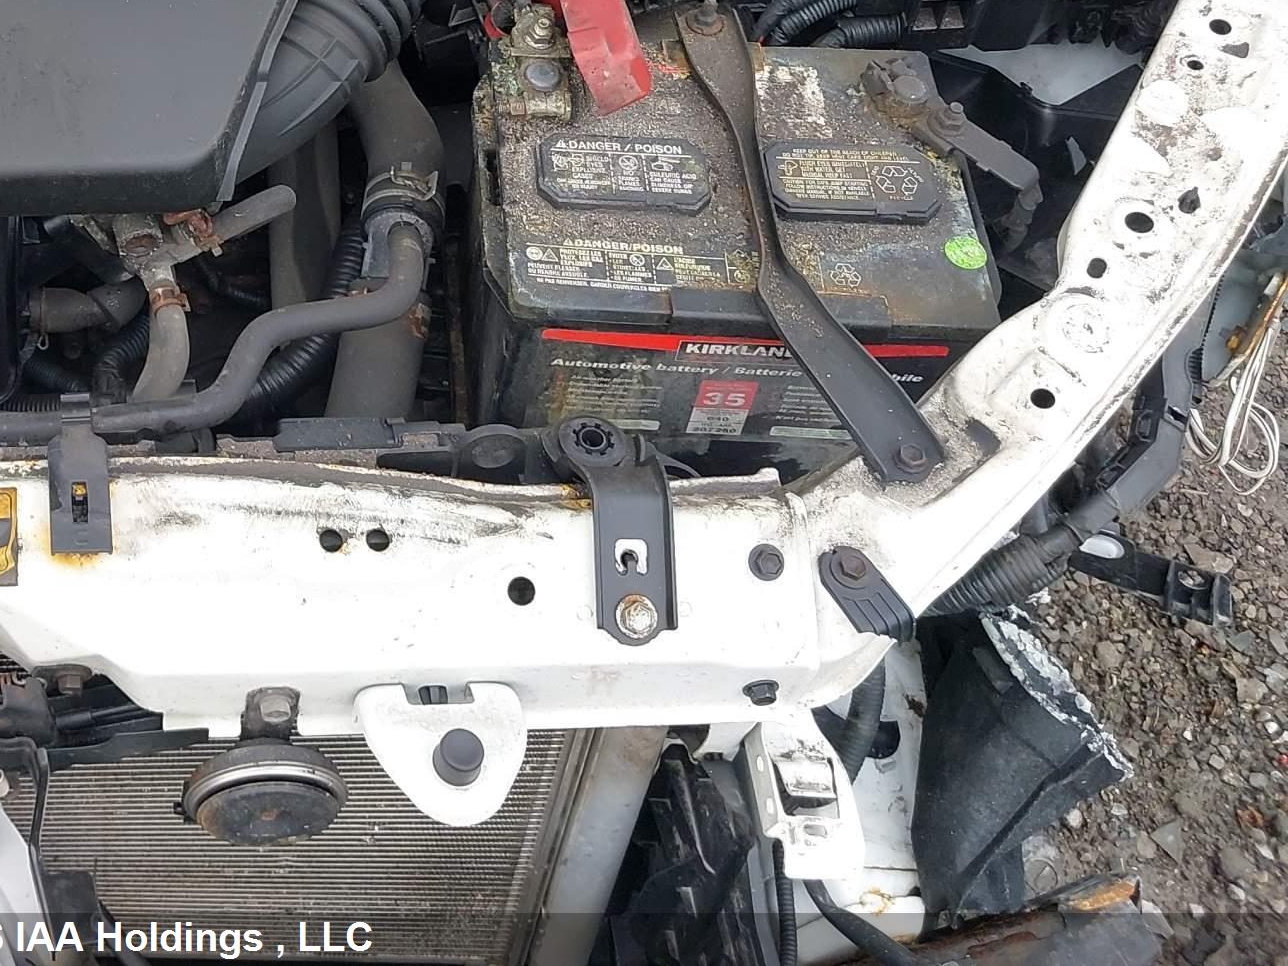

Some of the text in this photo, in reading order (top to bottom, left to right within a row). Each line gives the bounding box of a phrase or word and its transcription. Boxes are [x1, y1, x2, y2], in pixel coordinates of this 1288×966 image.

[567, 140, 621, 152] DANGER
[634, 143, 682, 155] POISON
[574, 239, 684, 255] DANGER/POISON
[550, 357, 651, 372] Automotive
[656, 362, 719, 377] battery
[733, 366, 803, 378] Batterie
[703, 392, 746, 406] 35
